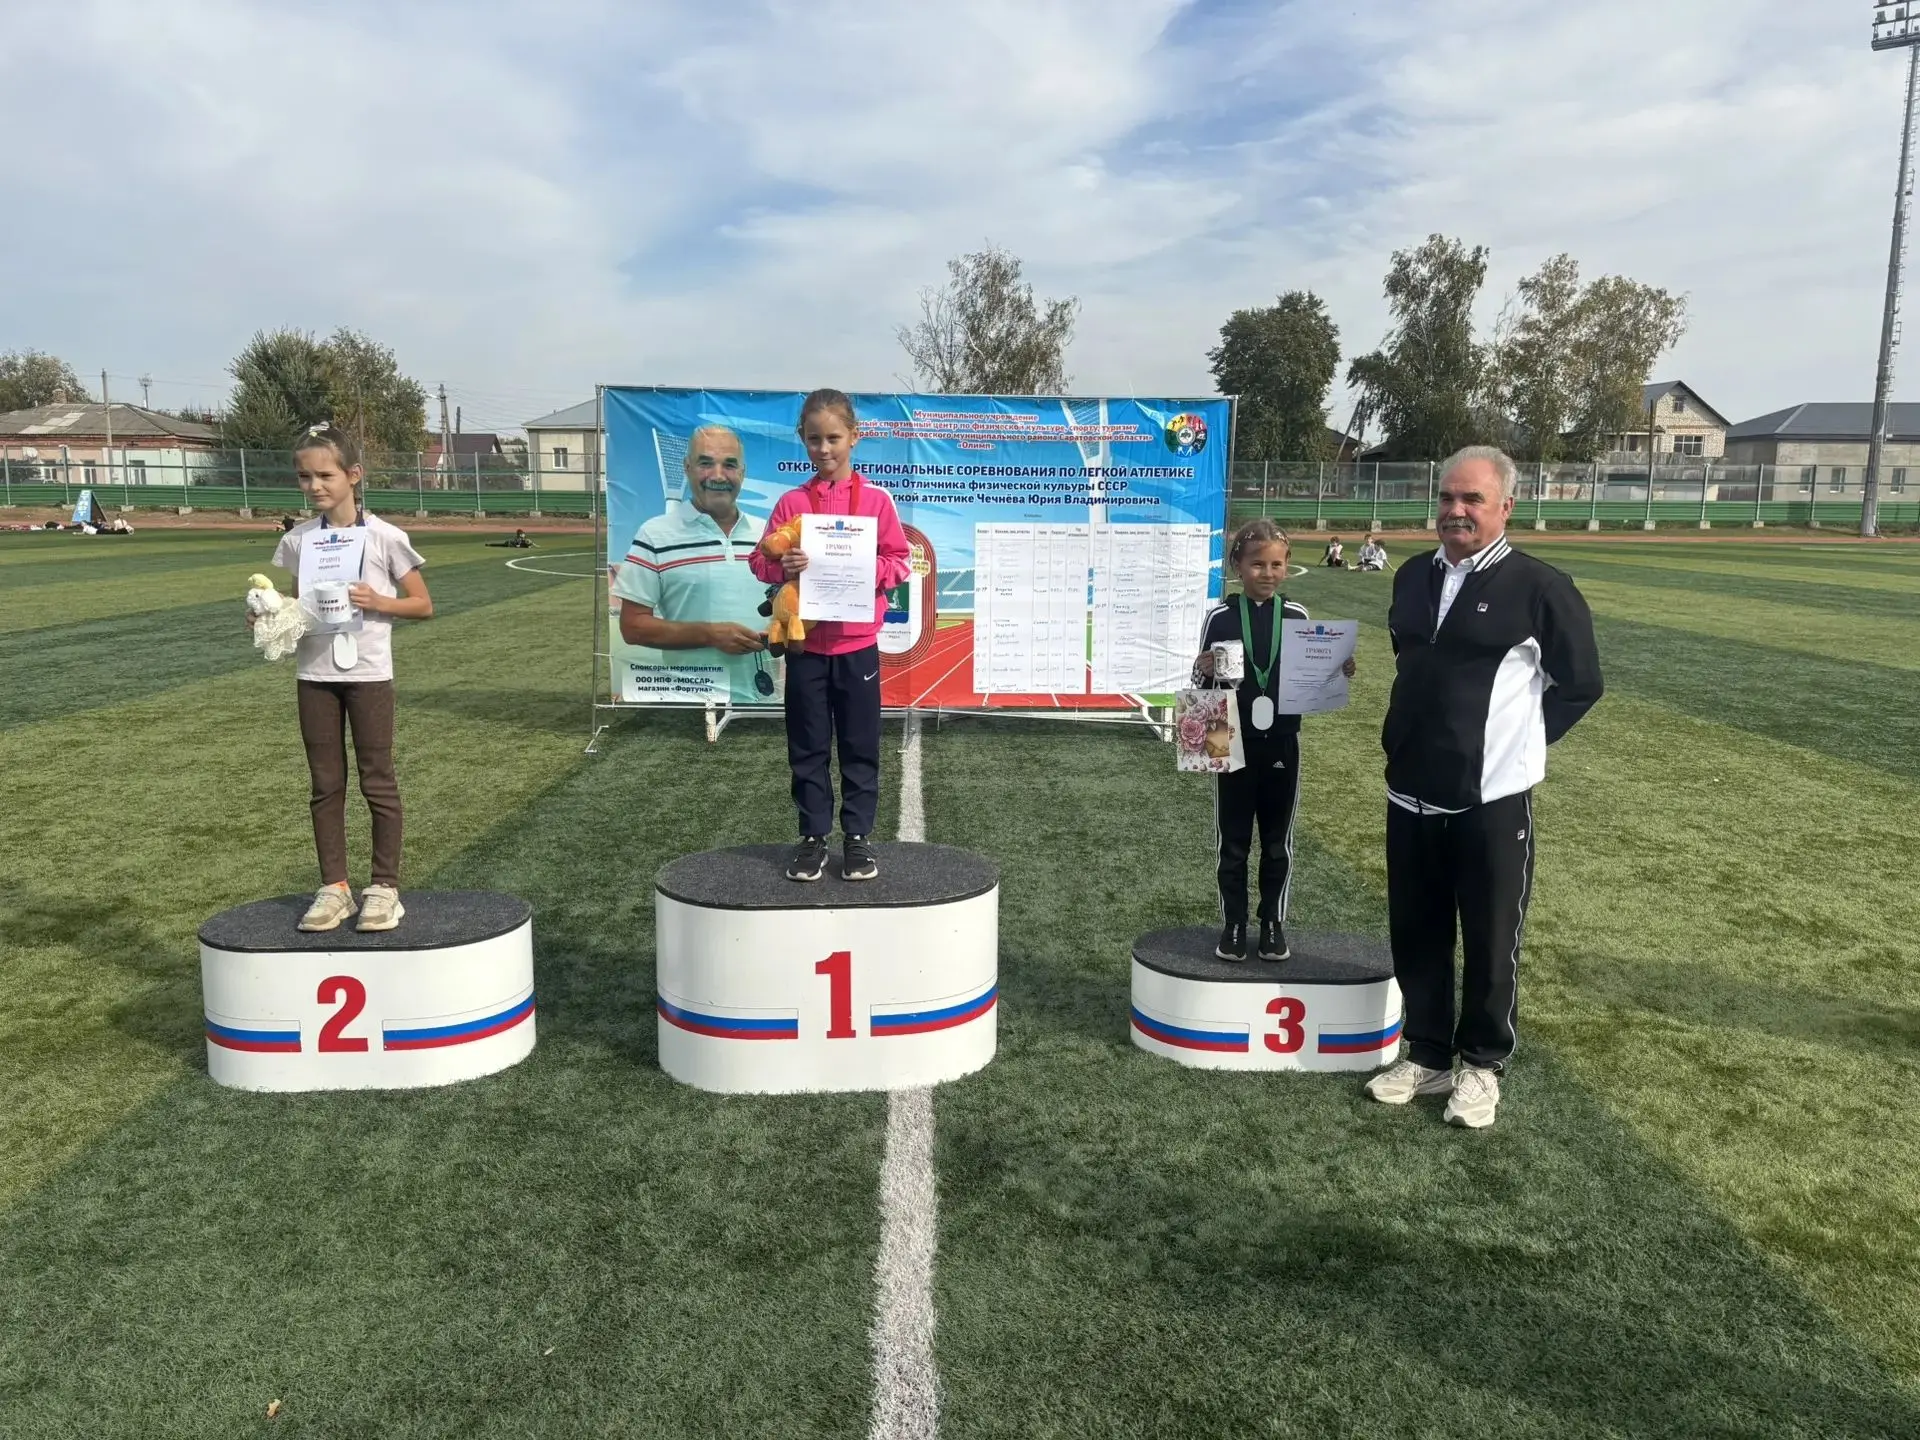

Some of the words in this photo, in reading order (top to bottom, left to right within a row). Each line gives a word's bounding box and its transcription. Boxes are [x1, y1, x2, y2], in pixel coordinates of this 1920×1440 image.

[913, 410, 984, 421] Муниципальное
[985, 412, 1039, 422] учреждение
[880, 421, 932, 430] спортивный
[933, 422, 957, 431] центр
[971, 422, 1025, 432] физической
[1101, 424, 1138, 433] туризму
[860, 430, 889, 439] работе
[892, 430, 952, 440] Марксовского
[953, 432, 1026, 442] муниципального
[1027, 433, 1058, 442] района
[1059, 433, 1113, 442] Саратовской
[958, 441, 995, 450] «Олимп»
[853, 463, 954, 475] РЕГИОНАЛЬНЫЕ
[957, 465, 1056, 477] СОРЕВНОВАНИЯ
[1059, 467, 1076, 477] ПО
[1078, 465, 1127, 478] ЛЕГКОЙ
[1130, 466, 1194, 478] АТЛЕТИКЕ
[901, 478, 966, 490] Отличника
[968, 480, 1041, 492] физической
[1043, 482, 1095, 493] кульуры
[1097, 481, 1128, 491] СССР
[921, 494, 974, 504] атлетике
[977, 493, 1026, 504] Чечнёва
[1028, 494, 1062, 506] Юрия
[1064, 494, 1160, 506] Владимировича
[630, 663, 669, 672] Спонсоры
[670, 664, 724, 673] мероприятия:
[815, 951, 856, 1039] 1
[317, 975, 369, 1053] 2
[1264, 997, 1306, 1053] 3
